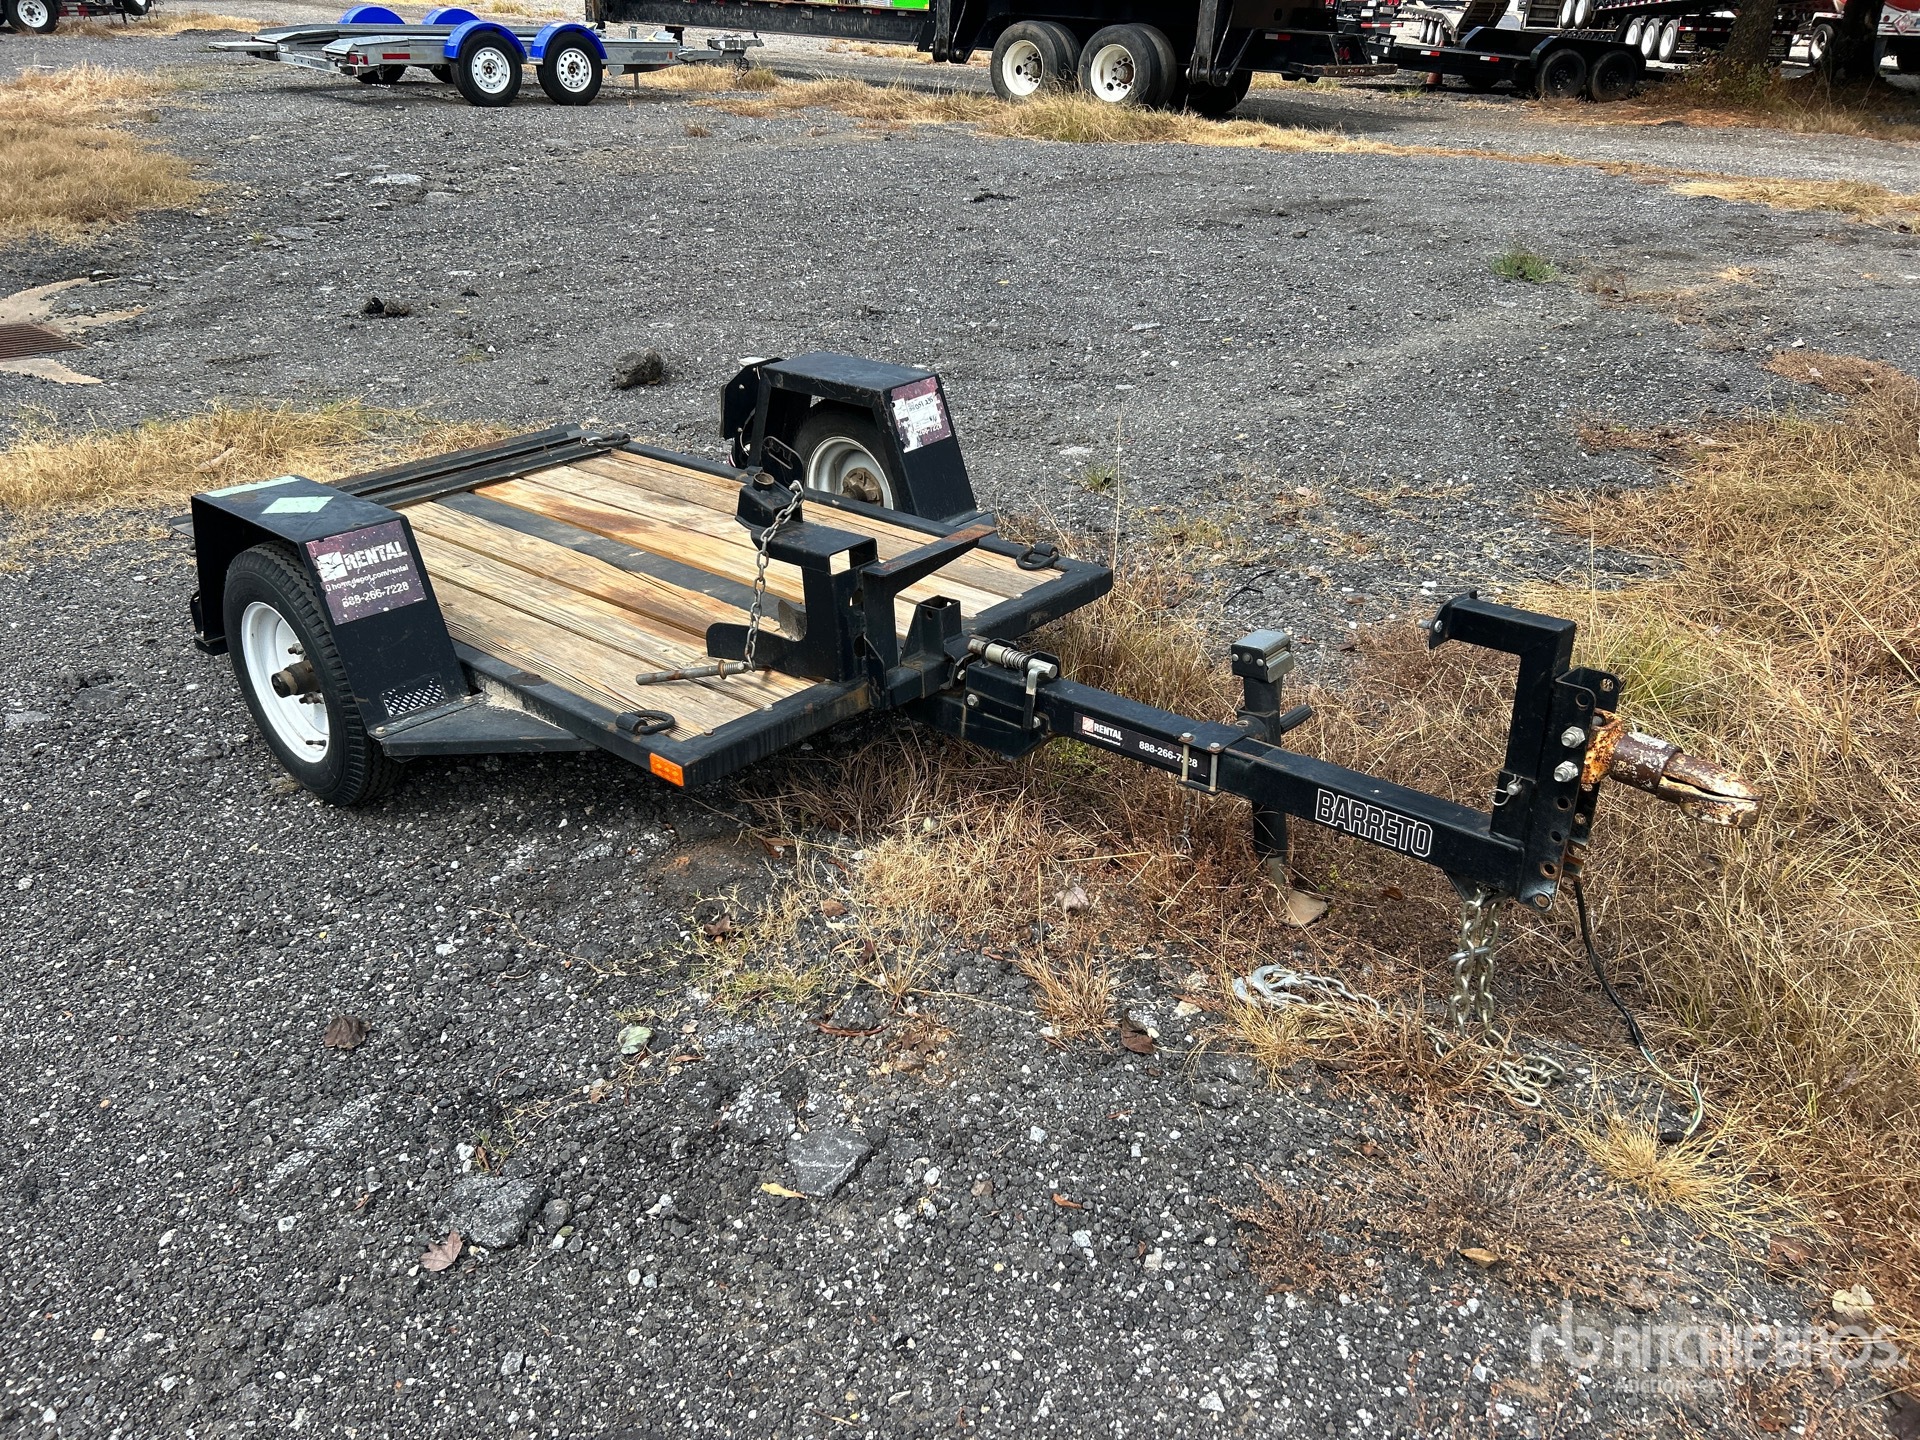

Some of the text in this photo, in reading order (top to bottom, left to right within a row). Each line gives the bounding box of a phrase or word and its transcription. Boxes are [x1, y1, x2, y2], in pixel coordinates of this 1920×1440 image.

[342, 541, 408, 571] RENTAL
[1093, 723, 1123, 741] RENTAL
[1315, 788, 1433, 858] BARRETO
